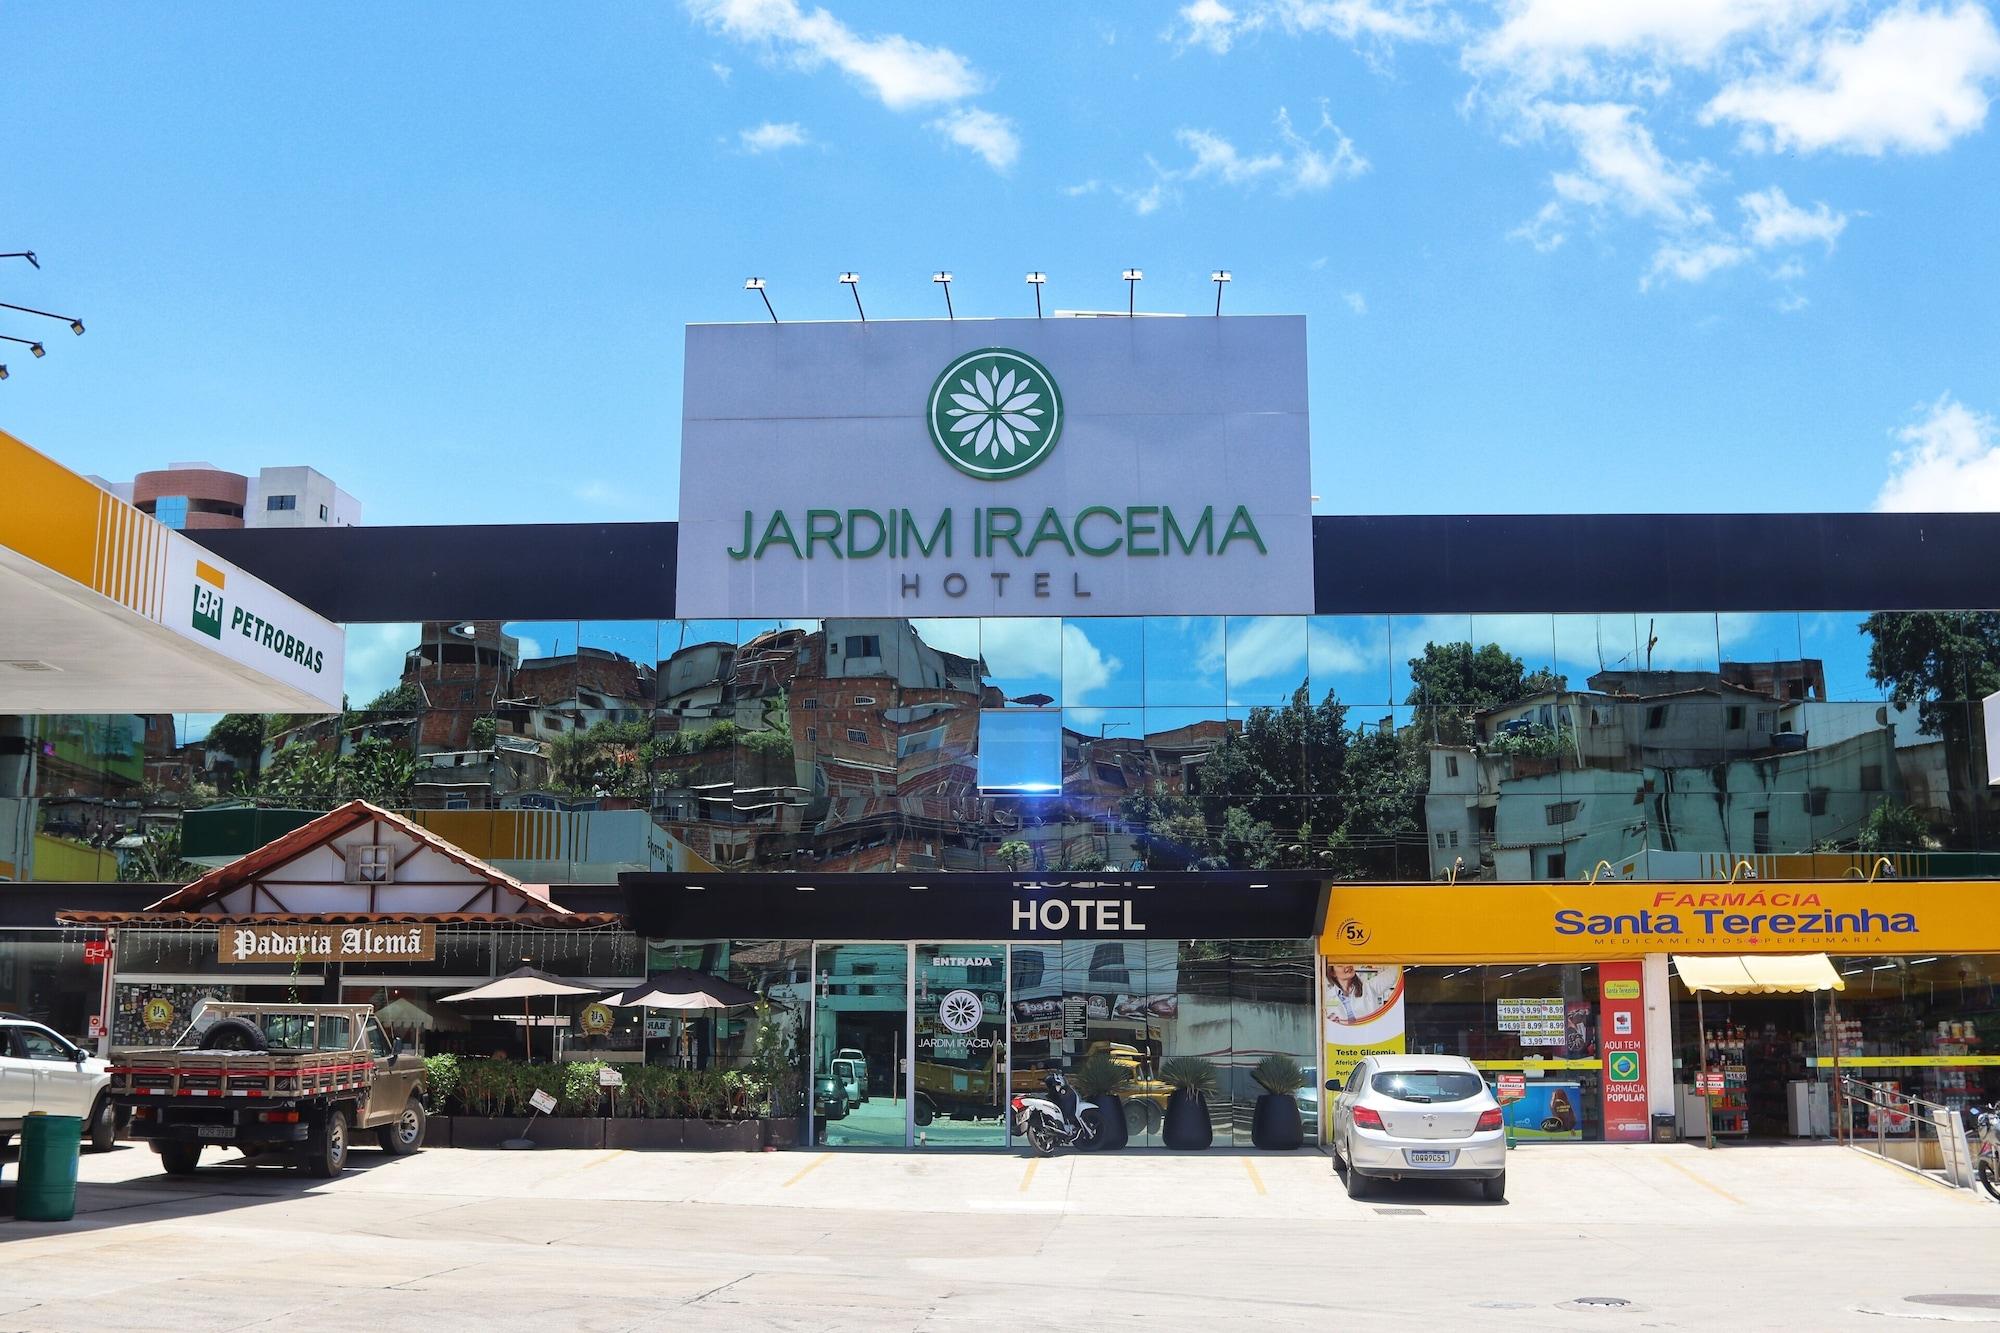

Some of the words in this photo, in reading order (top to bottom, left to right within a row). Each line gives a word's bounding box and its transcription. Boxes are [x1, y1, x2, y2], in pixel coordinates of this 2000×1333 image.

[727, 507, 952, 560] JARDIM
[974, 504, 1268, 558] IRACEMA
[900, 571, 1092, 599] HOTEL
[195, 585, 221, 622] BR
[231, 605, 323, 674] PETROBRAS
[1652, 889, 1822, 907] FARMÁCIA
[1012, 899, 1146, 931] HOTEL
[1554, 909, 1683, 935] Santa
[1693, 907, 1919, 935] Terezinha
[1346, 926, 1364, 940] 5x
[1594, 937, 1743, 945] MEDICAMENTOS
[1764, 936, 1882, 944] PERFUMARIA
[232, 929, 332, 960] Padaria
[341, 928, 422, 955] Alemã
[932, 957, 992, 967] ENTRADA
[918, 1039, 955, 1048] JARDIM
[956, 1039, 1004, 1048] IRACEMA
[1604, 1041, 1623, 1049] AQUI
[1624, 1041, 1641, 1049] TEM
[1605, 1083, 1646, 1093] FARMÁCIA
[1607, 1093, 1645, 1102] POPULAR
